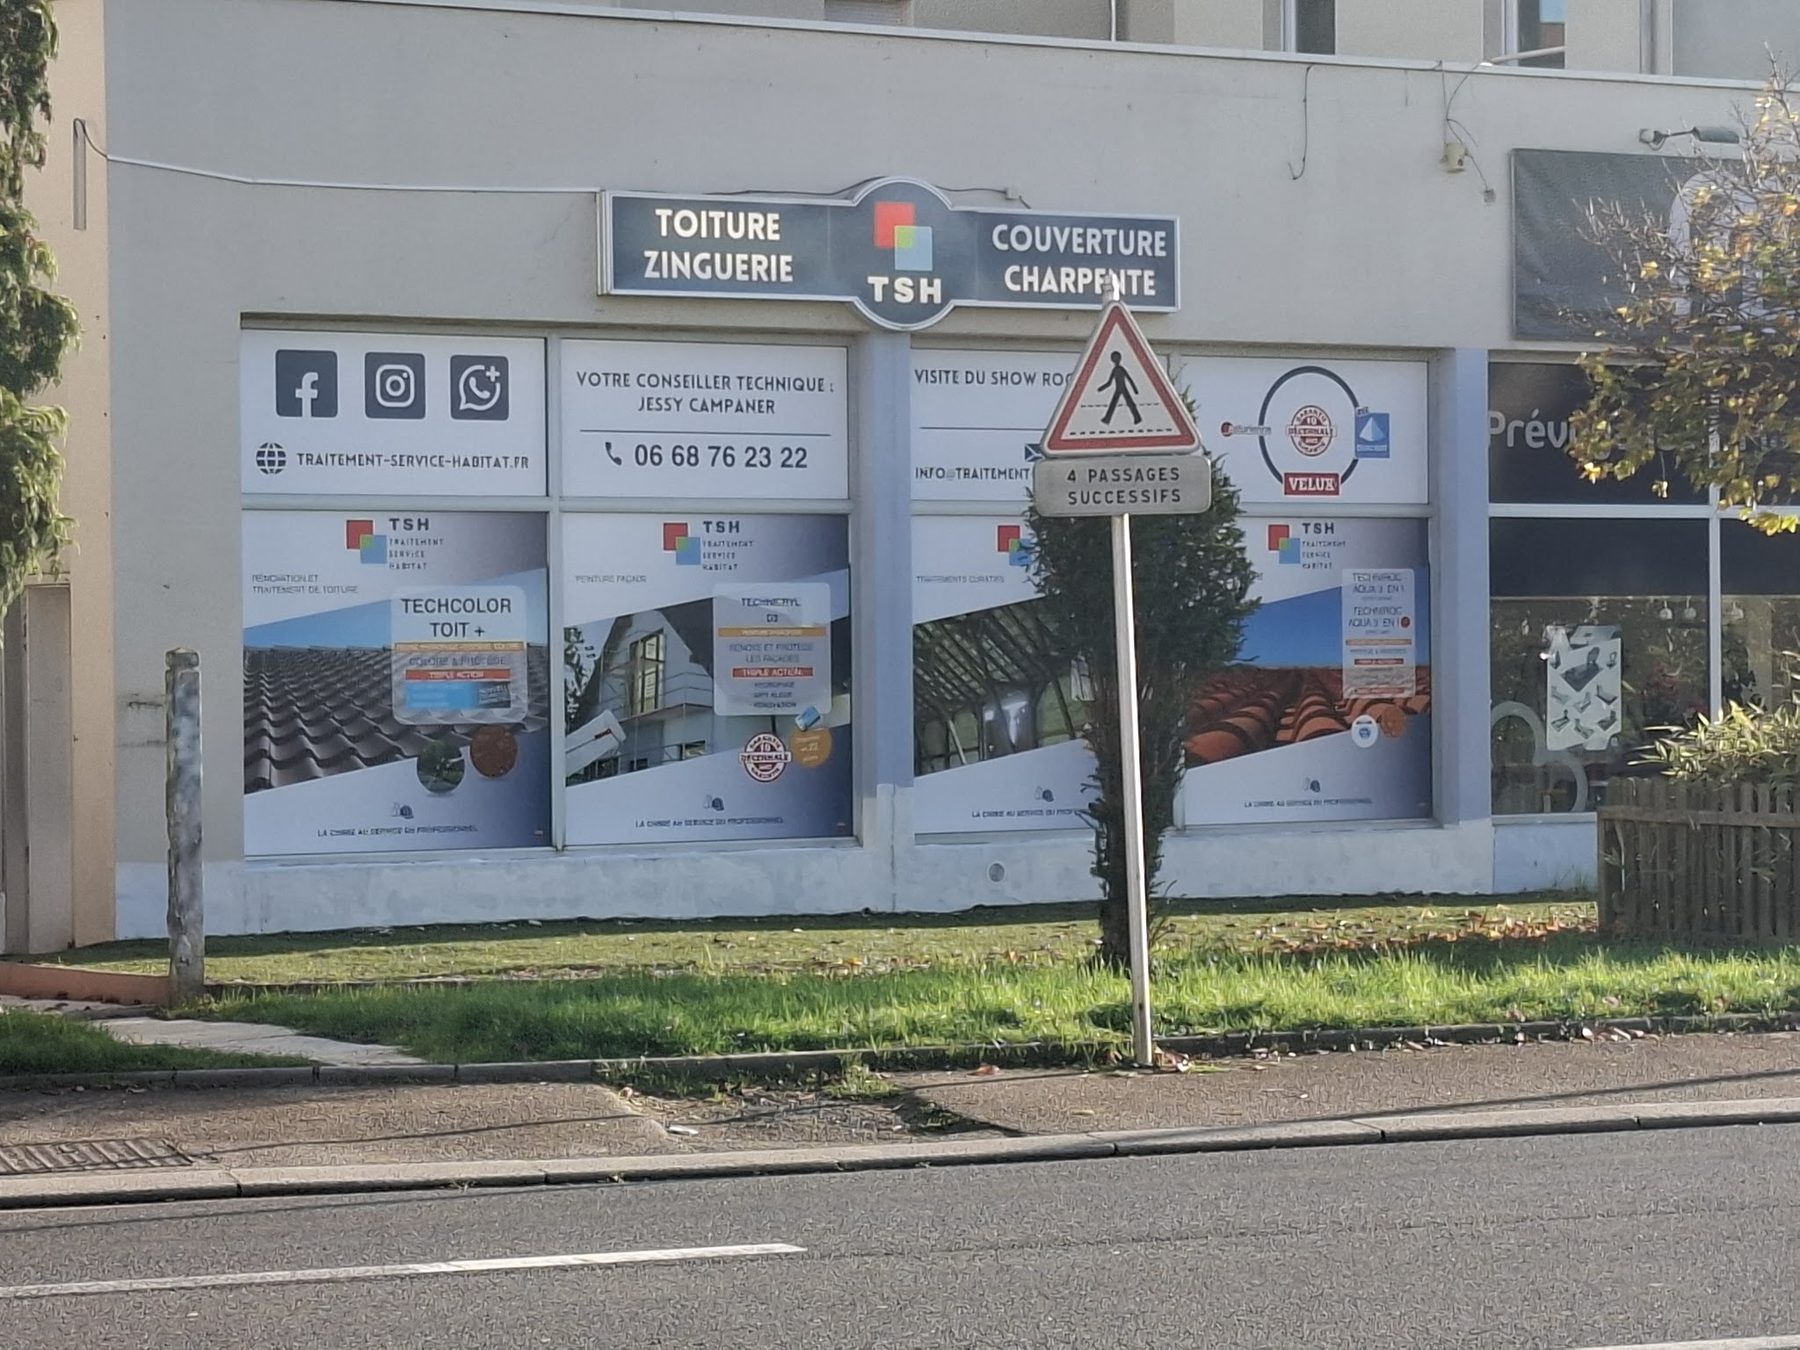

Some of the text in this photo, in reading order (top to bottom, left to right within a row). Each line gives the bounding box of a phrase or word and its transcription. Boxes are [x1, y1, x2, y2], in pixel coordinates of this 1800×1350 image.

[655, 207, 781, 241] TOITURE
[991, 223, 1168, 258] COUVERTURE
[643, 249, 794, 284] ZINGUERIE
[1003, 263, 1156, 297] CHARPENTE
[867, 276, 942, 305] TSH
[576, 371, 631, 388] VOTRE
[636, 373, 731, 391] CONSEILLER
[736, 375, 825, 393] TECHNIQUE
[914, 369, 960, 386] VISITE
[965, 370, 986, 386] DU
[991, 370, 1037, 387] SHOW
[637, 397, 776, 415] JESSY CAMPANER
[634, 444, 808, 469] 06 68 76 23 22
[1067, 468, 1181, 484] 4 PASSAGES
[1288, 477, 1335, 492] VELUX
[1068, 488, 1182, 506] SUCCESSIFS
[389, 518, 430, 531] TSH
[703, 520, 741, 533] TSH
[1301, 522, 1335, 535] TSH
[401, 598, 512, 614] TECHCOLOR
[430, 622, 470, 638] TOIT
